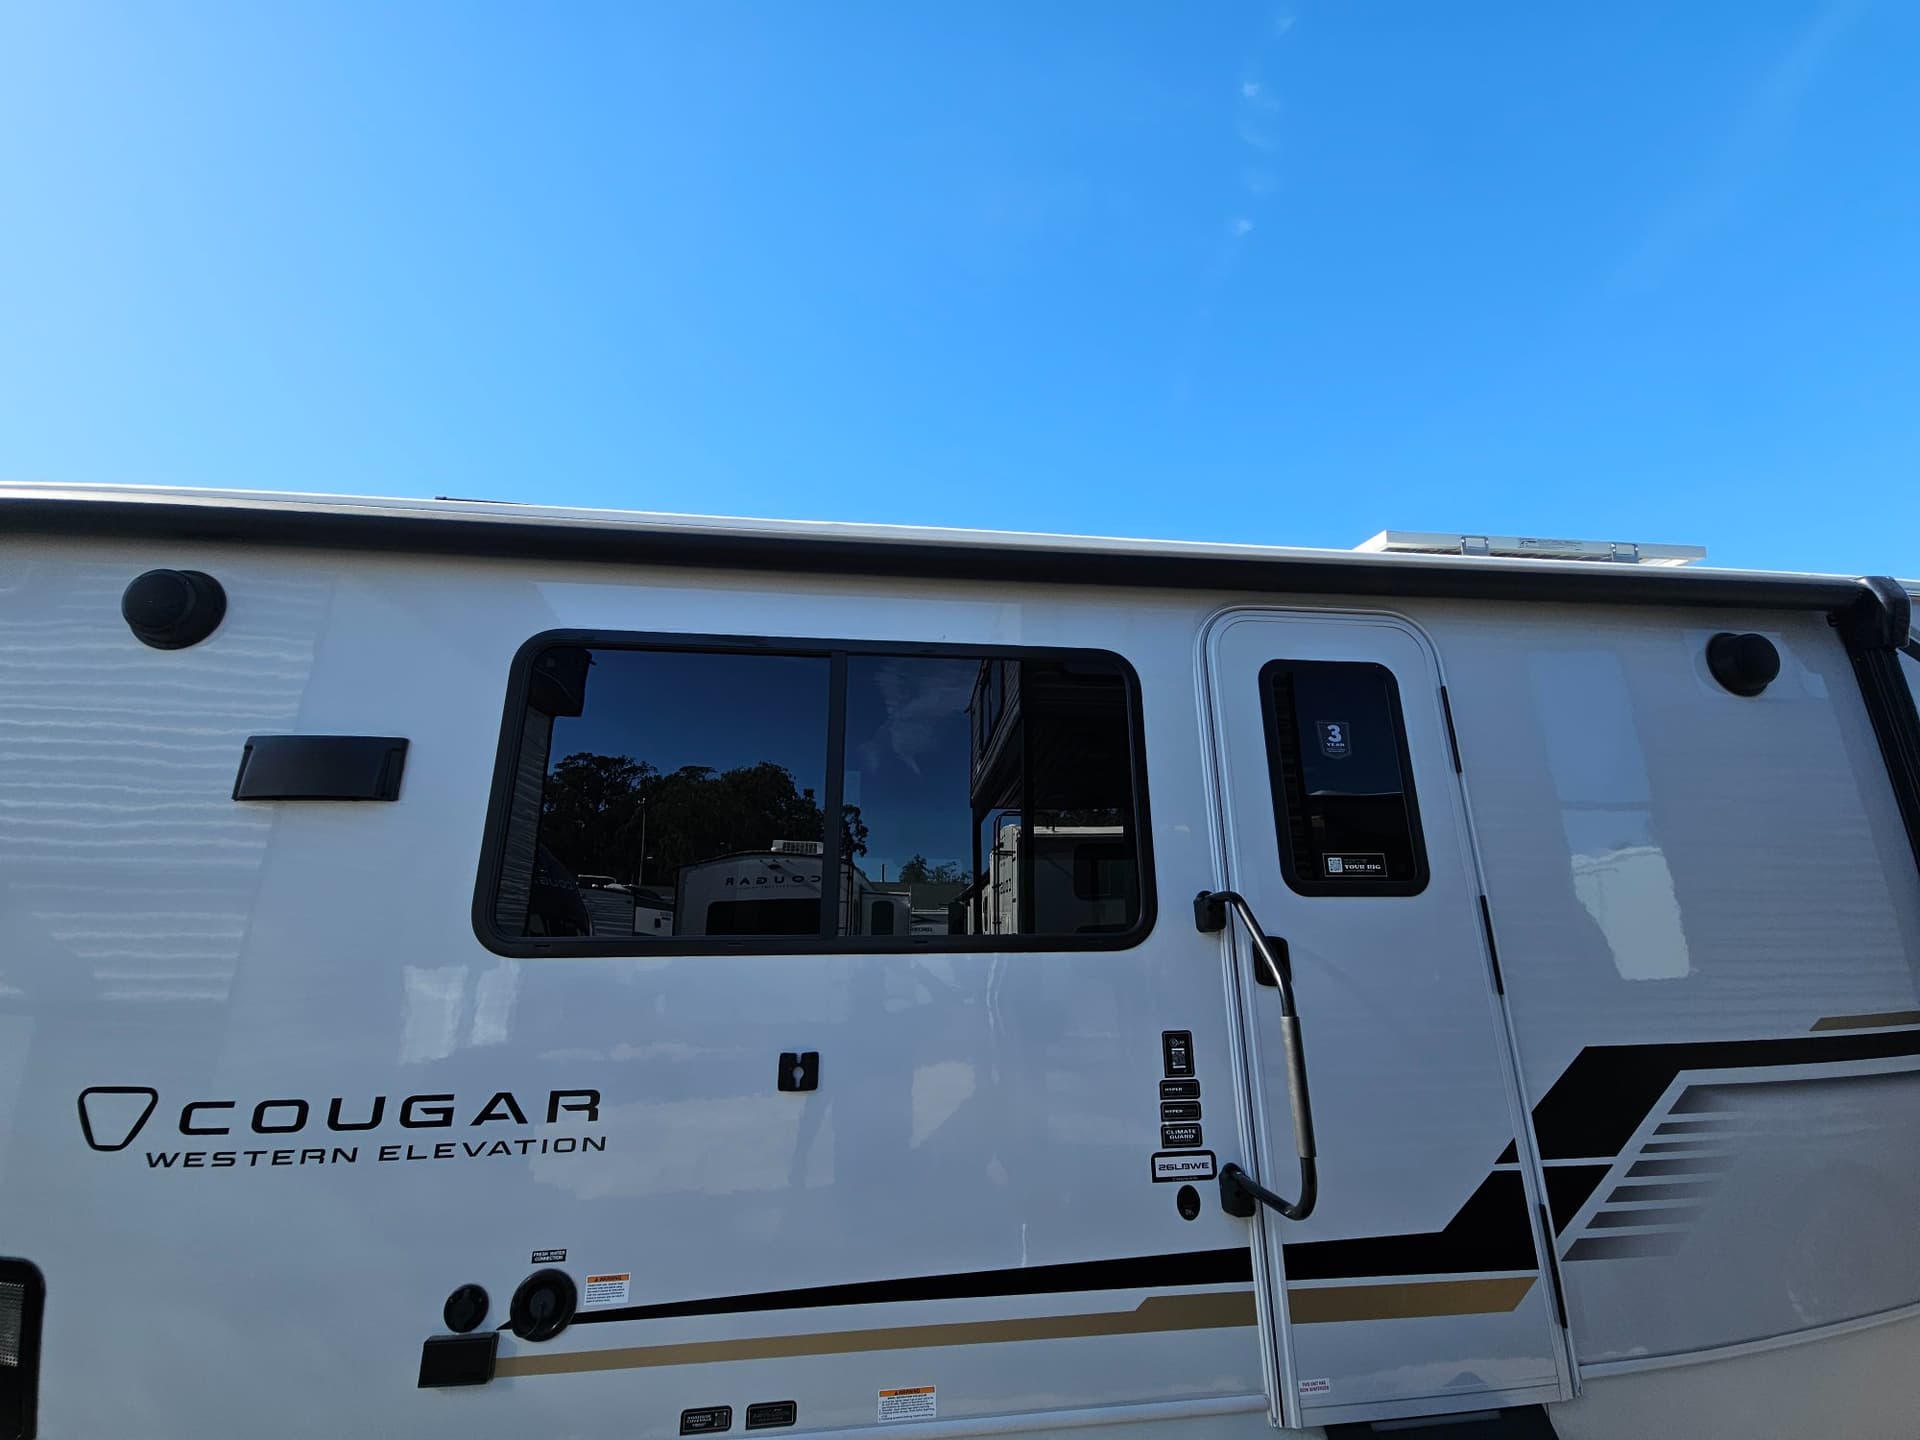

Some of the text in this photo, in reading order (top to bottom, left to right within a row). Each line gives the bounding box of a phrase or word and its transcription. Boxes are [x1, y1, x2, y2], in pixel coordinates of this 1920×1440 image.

[1327, 724, 1342, 743] 3
[179, 1089, 601, 1136] COUGAR
[146, 1136, 607, 1168] WESTERN ELEVATION
